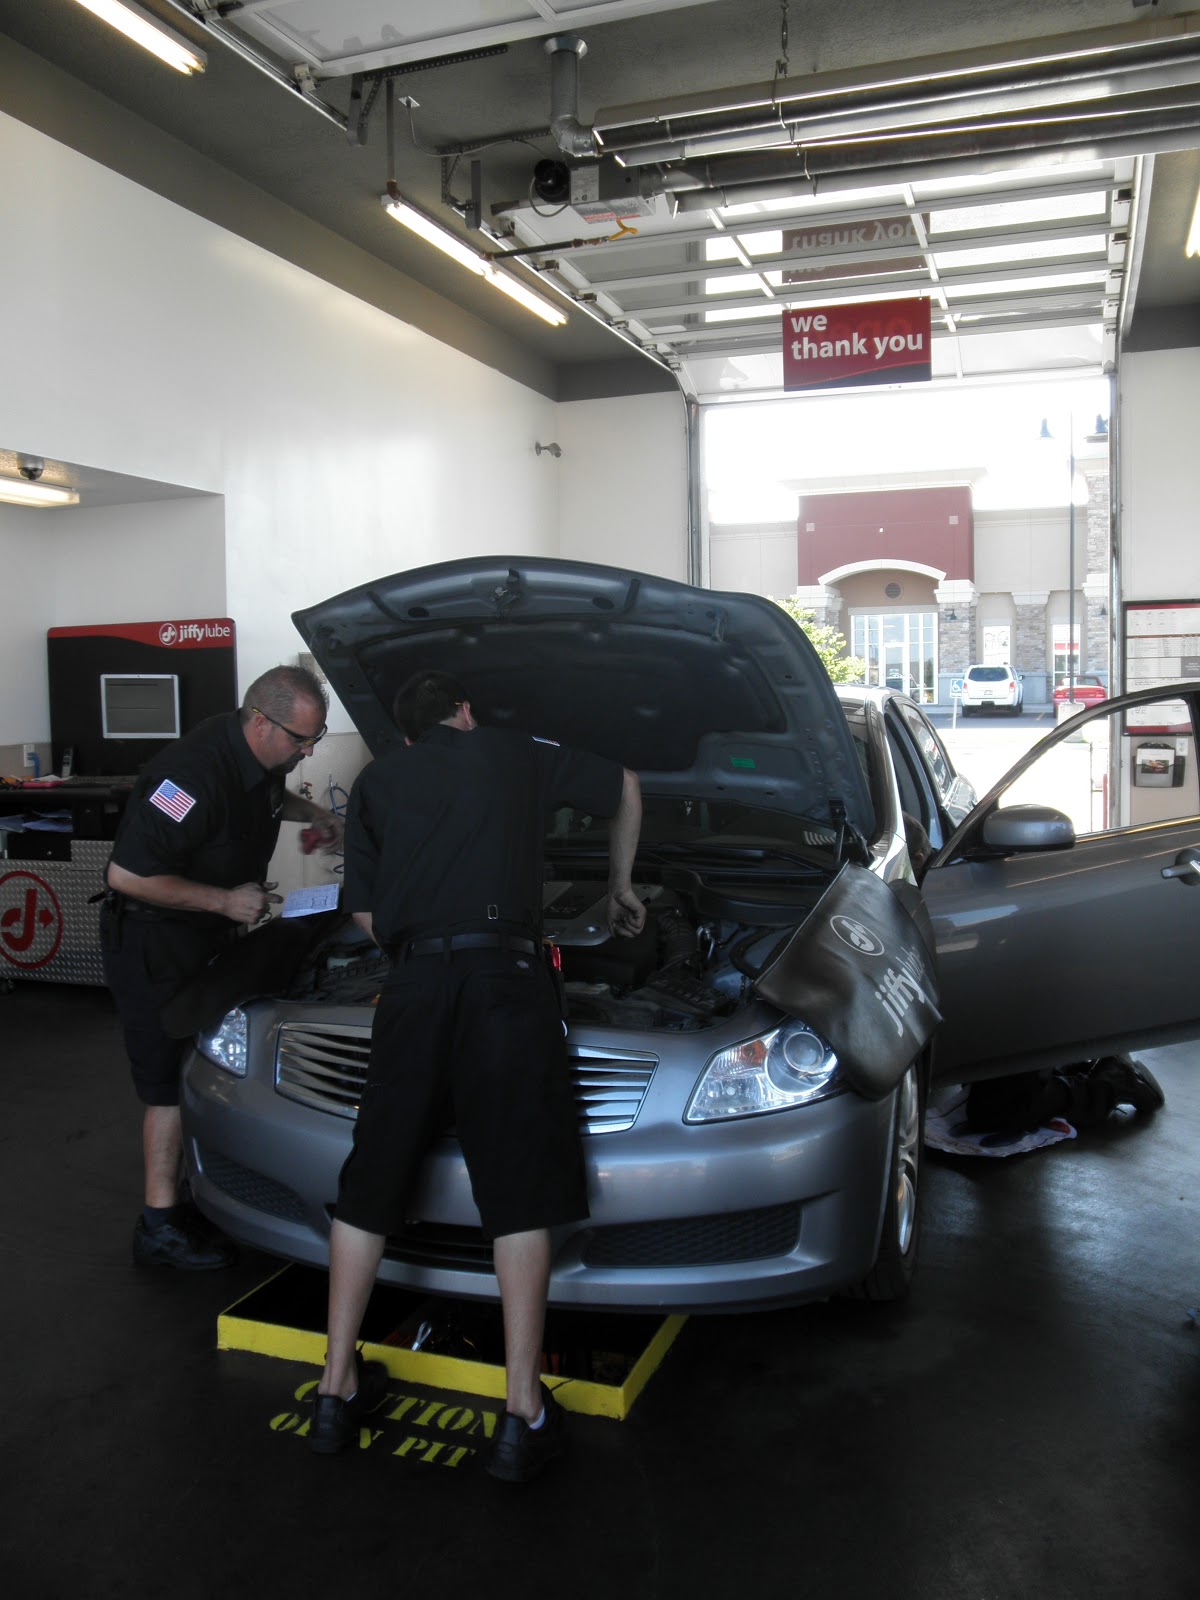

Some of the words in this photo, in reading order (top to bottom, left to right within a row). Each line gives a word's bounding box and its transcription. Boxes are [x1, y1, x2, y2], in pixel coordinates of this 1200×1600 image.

[791, 314, 828, 333] we
[791, 332, 868, 360] thank
[873, 333, 923, 360] you
[294, 1380, 497, 1439] CTION
[392, 1436, 477, 1468] PIT
